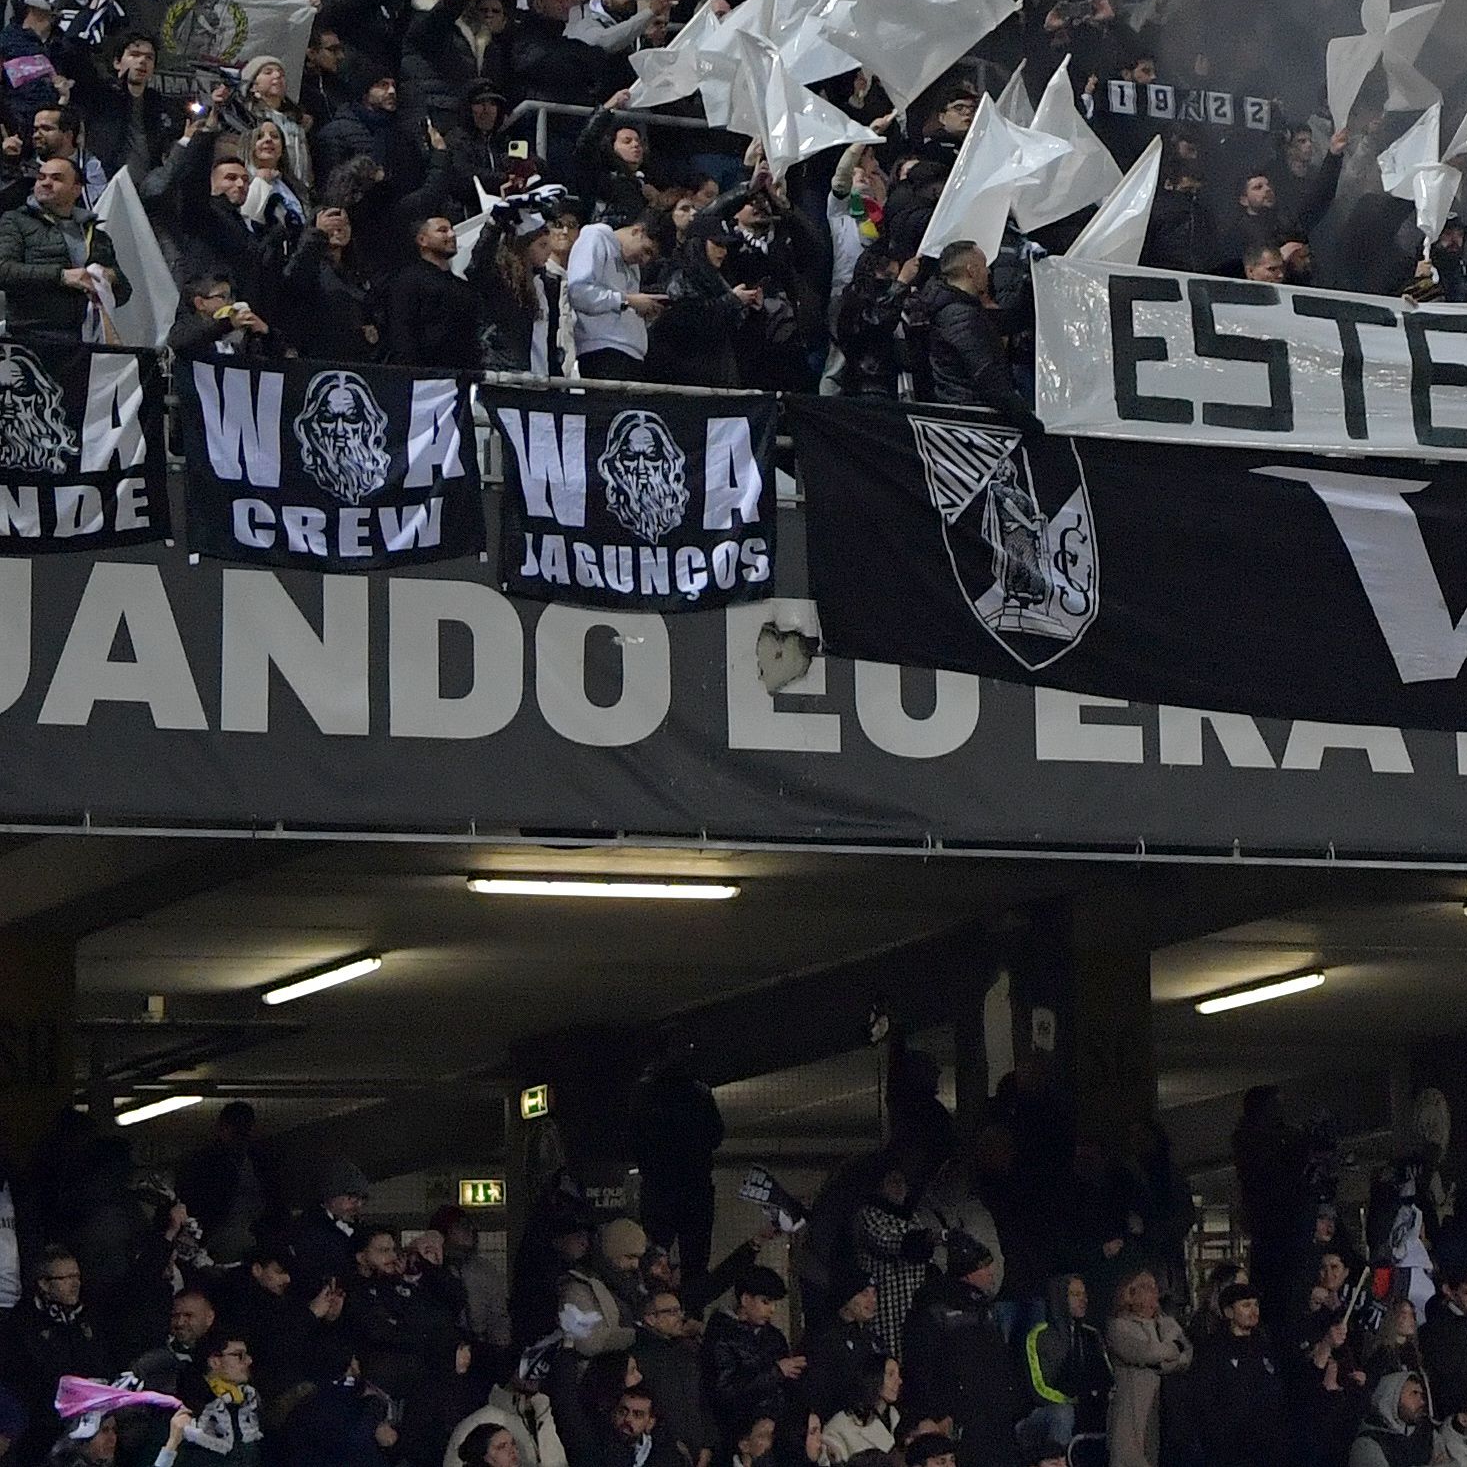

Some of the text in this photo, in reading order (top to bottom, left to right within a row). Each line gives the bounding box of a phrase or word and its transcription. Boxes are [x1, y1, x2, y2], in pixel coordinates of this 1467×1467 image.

[80, 352, 147, 474] A
[231, 496, 444, 559] CREW
[519, 535, 773, 600] JAGUNÇOS
